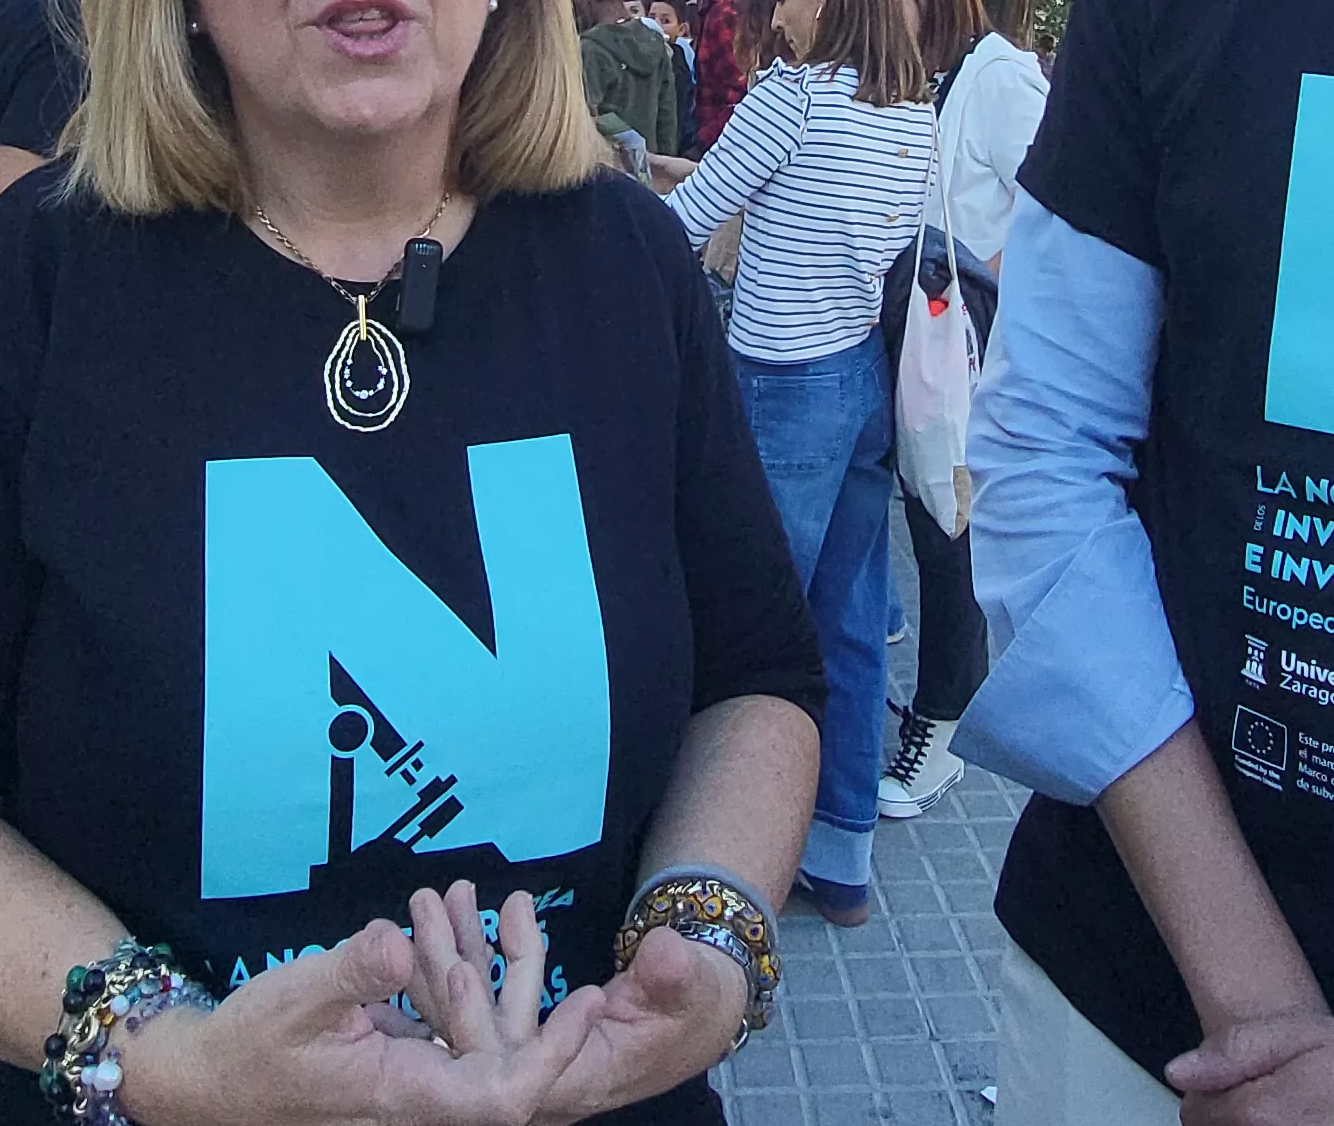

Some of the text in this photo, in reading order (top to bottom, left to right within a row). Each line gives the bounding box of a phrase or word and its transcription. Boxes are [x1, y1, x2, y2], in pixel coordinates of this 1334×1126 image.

[1256, 465, 1298, 499] LA
[1244, 541, 1264, 574] E
[1298, 731, 1320, 749] Este
[1298, 761, 1329, 782] Marco
[1296, 777, 1311, 792] de
